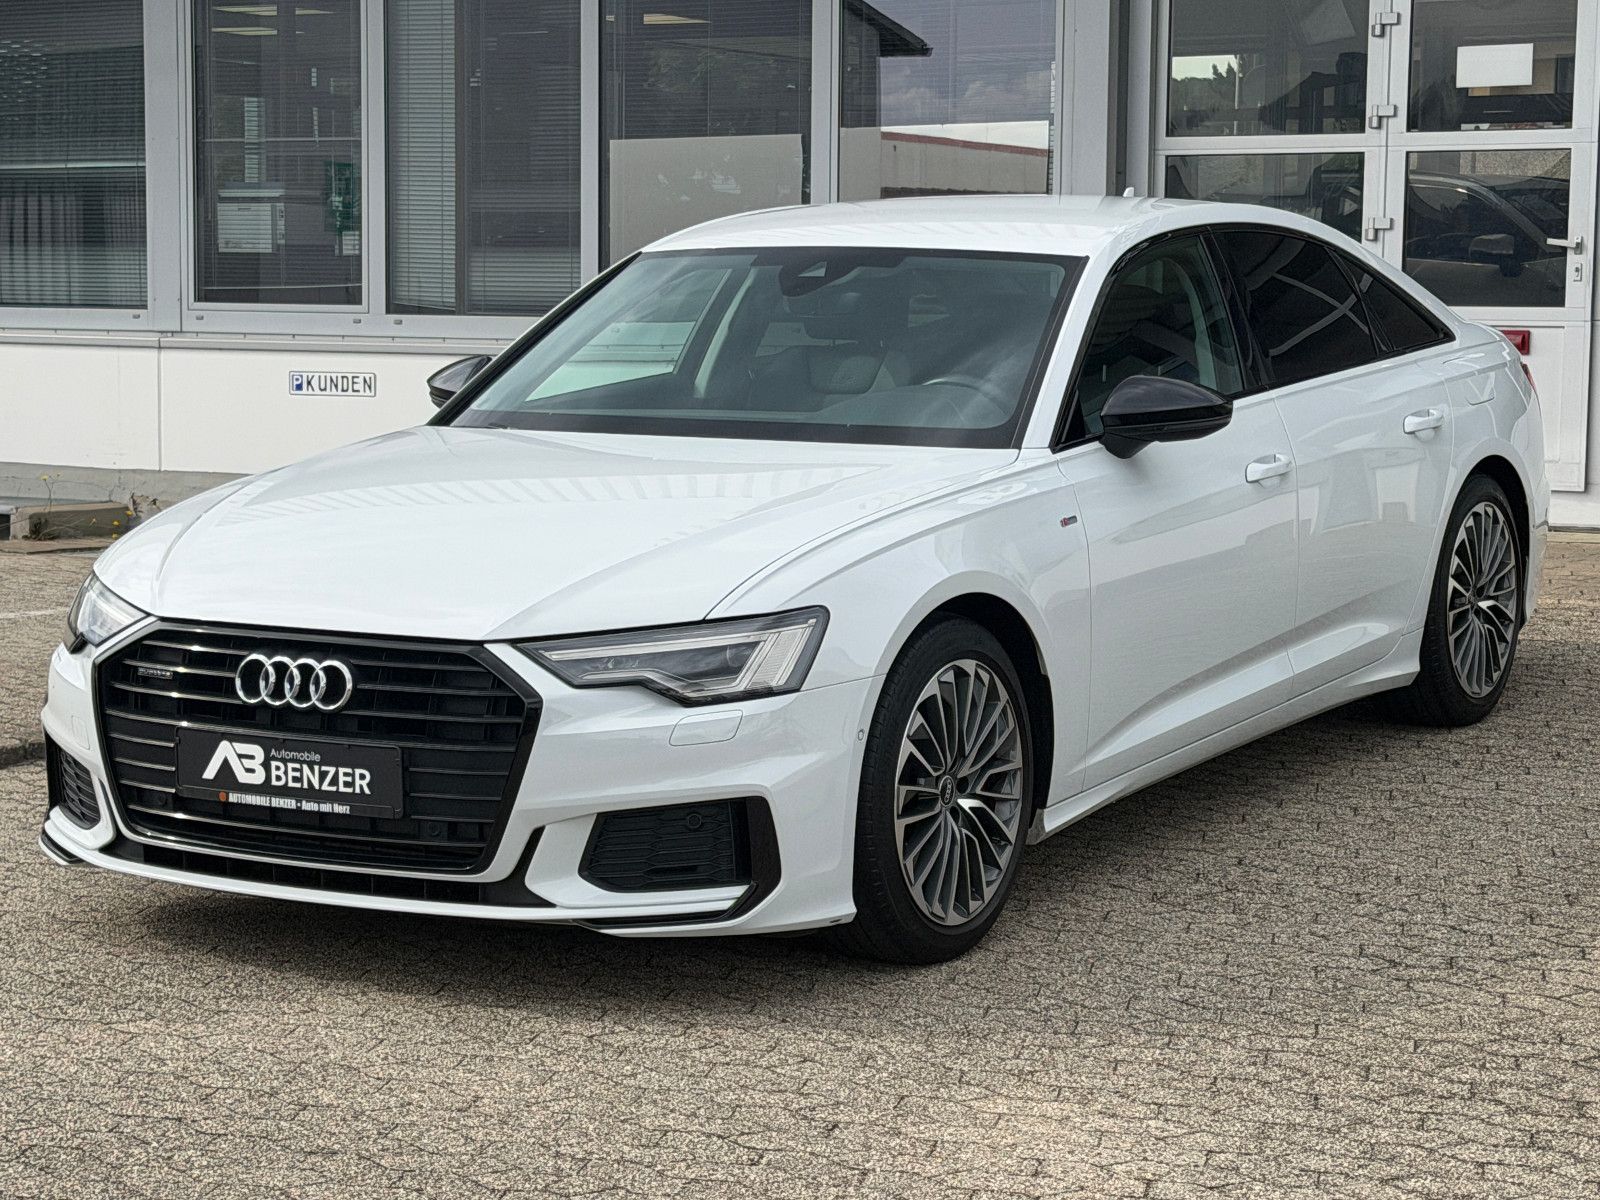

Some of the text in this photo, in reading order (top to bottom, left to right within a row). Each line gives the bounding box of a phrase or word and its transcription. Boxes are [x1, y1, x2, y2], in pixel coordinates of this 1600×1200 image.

[293, 375, 372, 393] P KUNDEN
[270, 748, 321, 762] Automobile
[270, 760, 371, 795] BENZER
[228, 792, 350, 815] AUTOMOBILE BENZER Auto mit Herz
